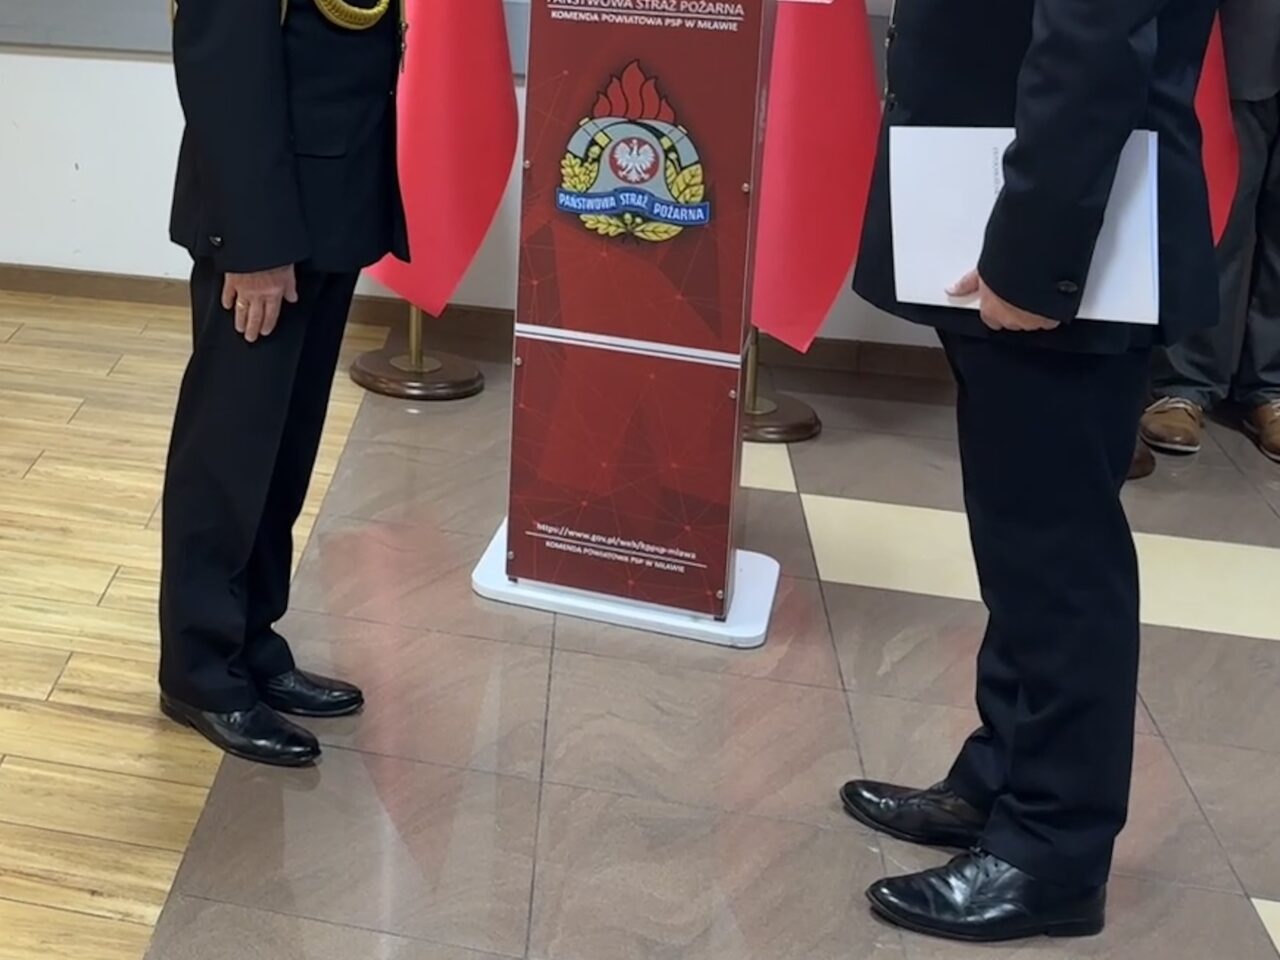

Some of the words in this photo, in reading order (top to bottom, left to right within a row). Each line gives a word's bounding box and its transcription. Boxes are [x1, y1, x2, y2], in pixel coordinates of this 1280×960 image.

[680, 0, 745, 16] POŻARNA
[551, 10, 599, 22] KOMENDA
[601, 13, 663, 27] POWIATOWA
[664, 18, 683, 28] PSP
[685, 18, 697, 29] W
[697, 20, 739, 32] MŁAWIE
[558, 193, 617, 211] PAŃSTWOWA
[619, 192, 648, 209] STRAŻ
[653, 201, 705, 221] POŻARNA
